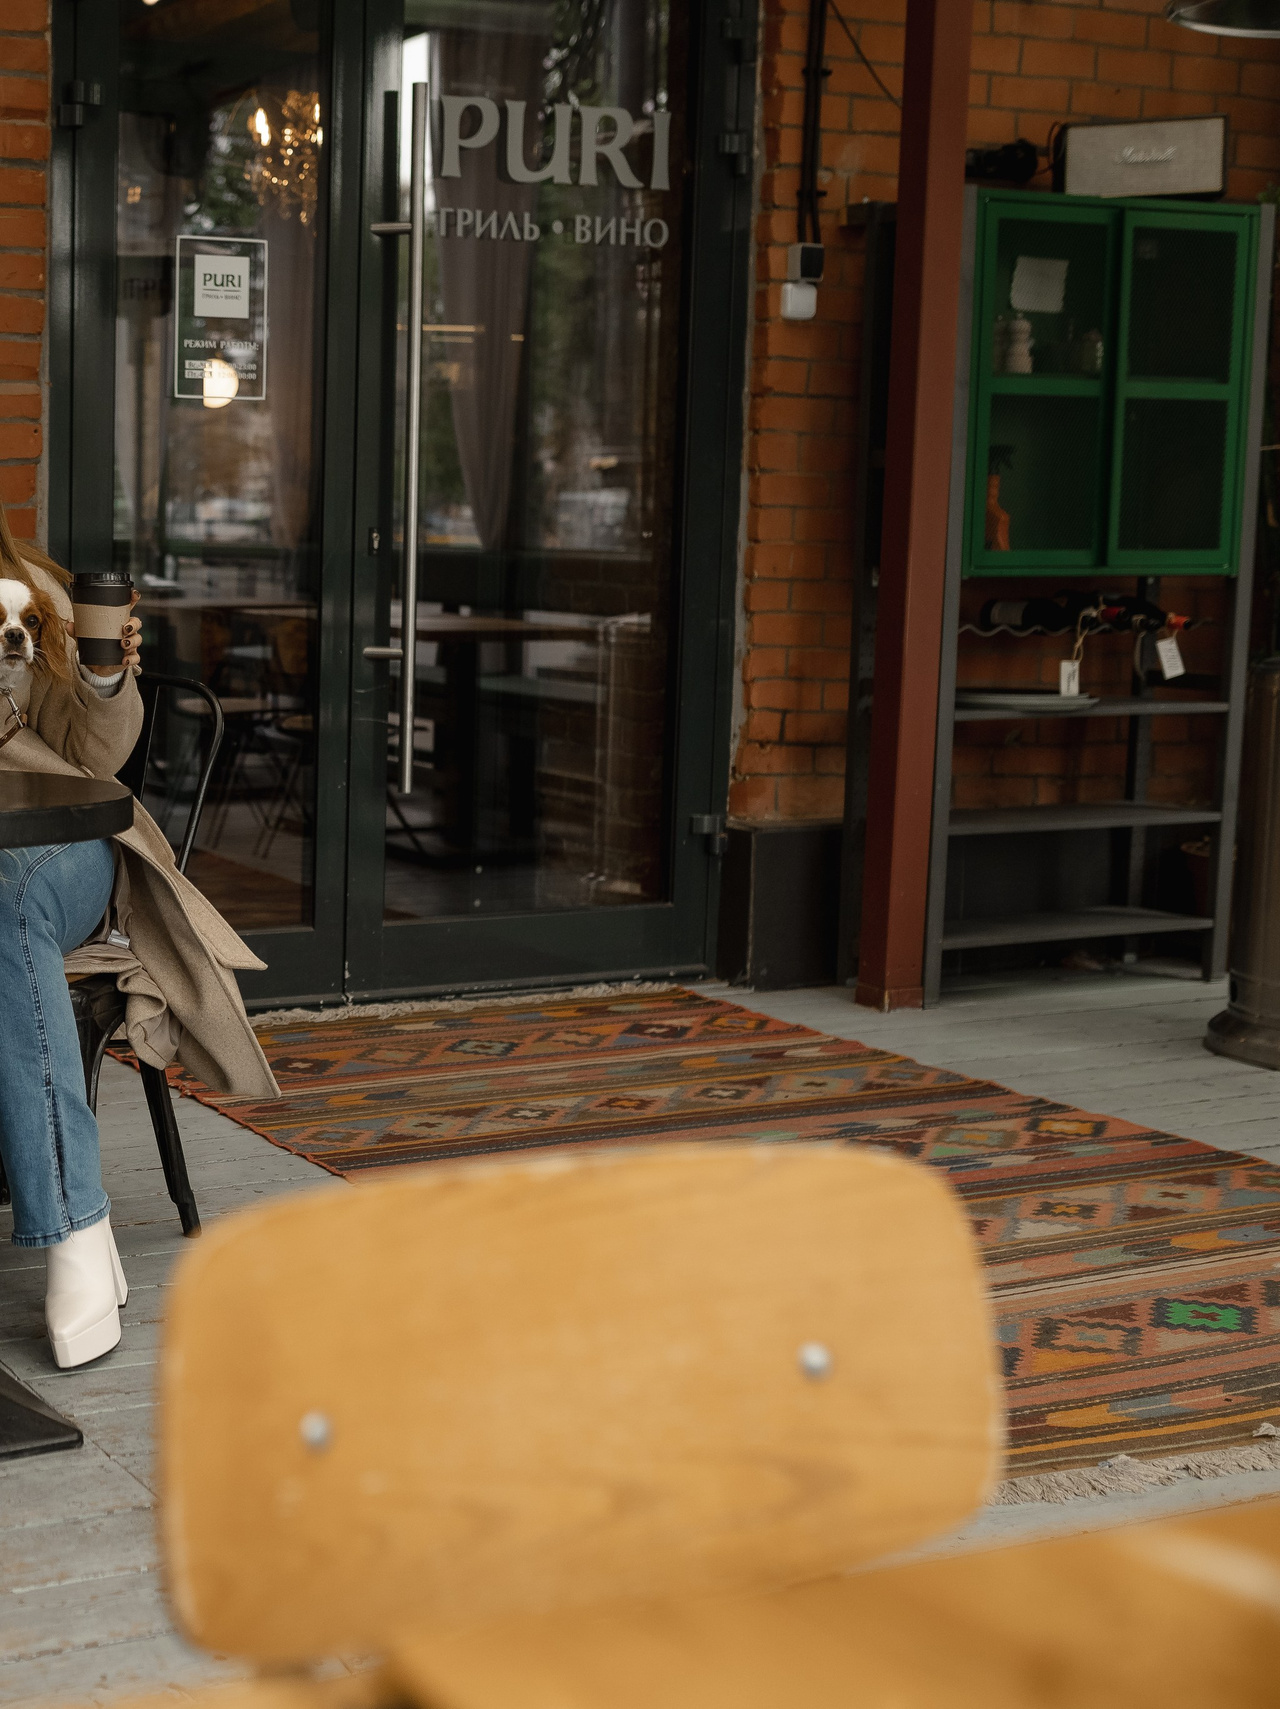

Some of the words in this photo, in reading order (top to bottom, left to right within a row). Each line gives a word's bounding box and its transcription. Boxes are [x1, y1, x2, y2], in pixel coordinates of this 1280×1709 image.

[441, 94, 671, 191] PURI
[439, 207, 541, 242] ГРИЛЬ
[574, 214, 669, 249] ВИНО
[203, 273, 241, 288] PURI
[183, 339, 217, 349] РЕЖИМ
